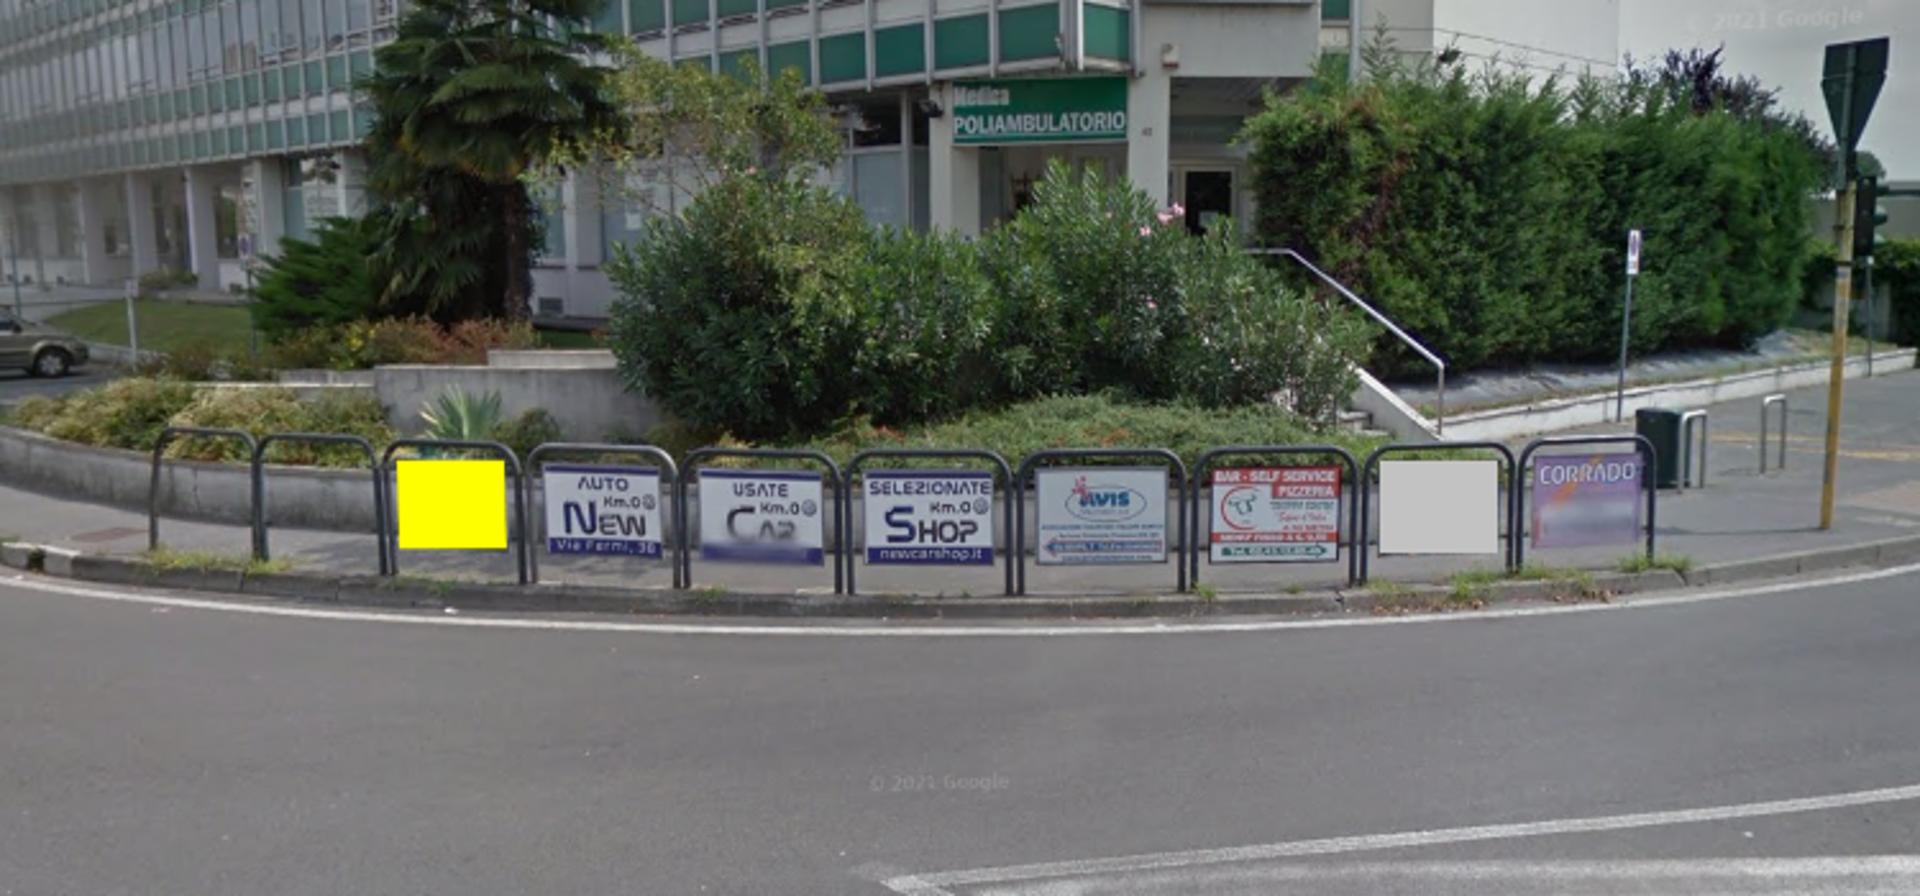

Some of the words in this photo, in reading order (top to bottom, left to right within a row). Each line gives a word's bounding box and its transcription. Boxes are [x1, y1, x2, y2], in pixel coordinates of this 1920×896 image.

[954, 111, 1125, 133] POLIAMBULATORIO
[1214, 470, 1240, 483] BAR
[1250, 470, 1280, 483] SELF
[1282, 470, 1335, 483] SERVICE
[1541, 462, 1635, 484] CORRADO
[578, 476, 629, 491] AUTO
[732, 483, 789, 498] USATE
[869, 481, 991, 496] SELEZIONATE
[1079, 490, 1130, 508] AVIS
[1278, 485, 1334, 498] PIZZERIA
[562, 501, 646, 537] NEW
[884, 506, 979, 543] SHOP
[557, 540, 581, 552] Via
[880, 548, 983, 563] newcarshop.it
